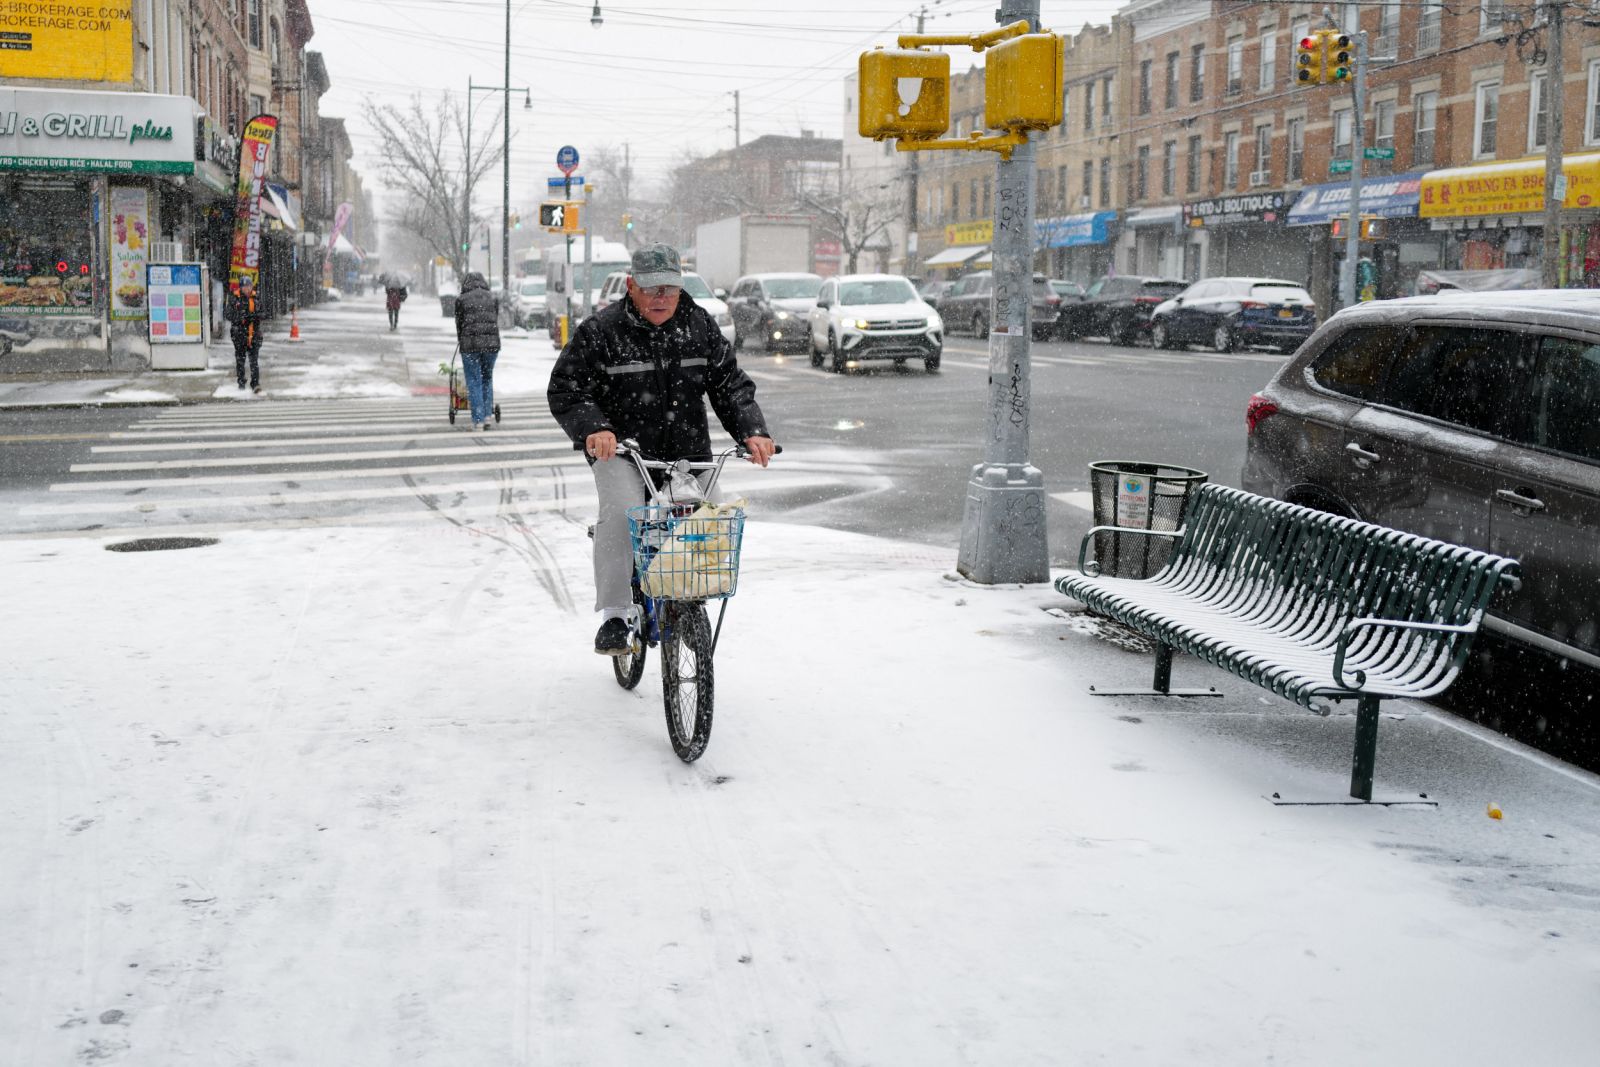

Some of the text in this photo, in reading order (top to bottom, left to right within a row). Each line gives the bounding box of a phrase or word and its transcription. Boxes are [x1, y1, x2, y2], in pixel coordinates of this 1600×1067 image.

[21, 118, 39, 137] &
[43, 112, 127, 139] GRILL
[130, 119, 173, 145] plus
[18, 158, 48, 166] CHICKEN
[50, 159, 67, 167] OVER
[69, 159, 85, 168] RICE
[90, 160, 113, 168] HALAL
[114, 161, 133, 169] FOOD
[1223, 195, 1274, 213] BOUTIQUE
[1319, 187, 1353, 204] LESTE
